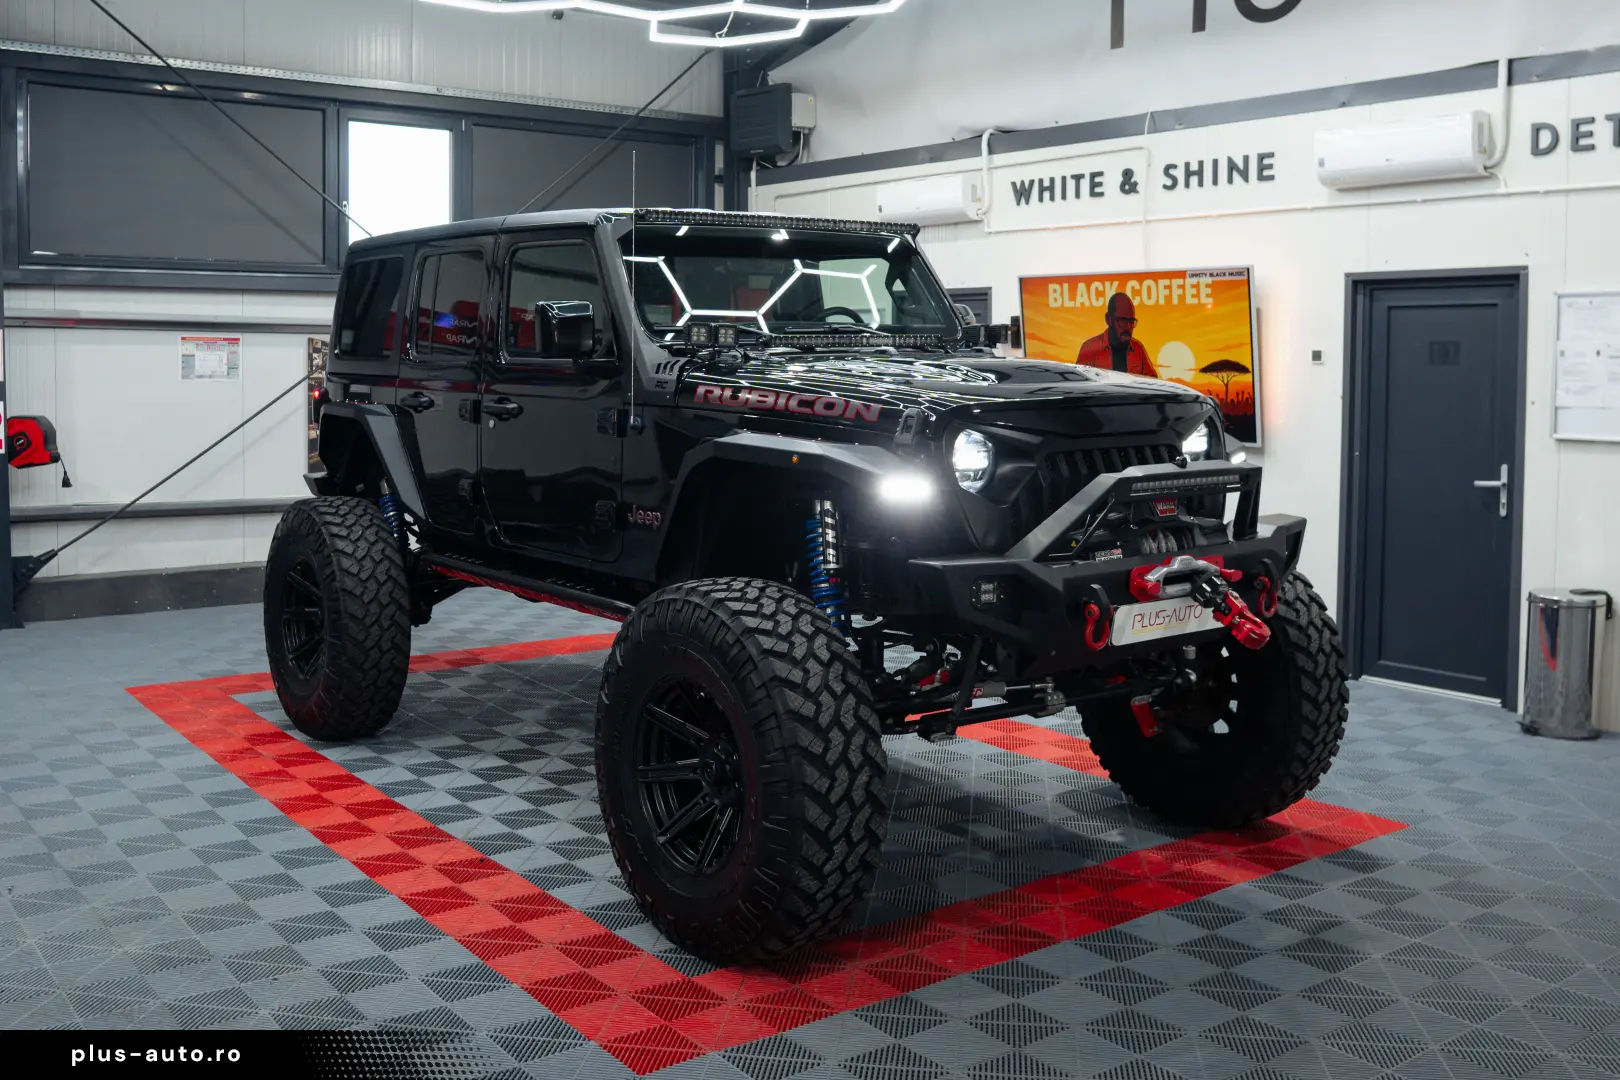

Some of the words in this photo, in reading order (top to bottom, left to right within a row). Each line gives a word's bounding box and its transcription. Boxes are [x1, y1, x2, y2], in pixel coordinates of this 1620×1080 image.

[1010, 170, 1105, 207] WHITE
[1119, 167, 1140, 195] &
[1162, 151, 1276, 191] SHINE
[1048, 280, 1119, 308] BLACK
[1126, 278, 1214, 306] COFFEE
[694, 384, 883, 422] RUBICON
[627, 504, 662, 530] Jeep
[1131, 604, 1203, 630] PLUS-AUTO
